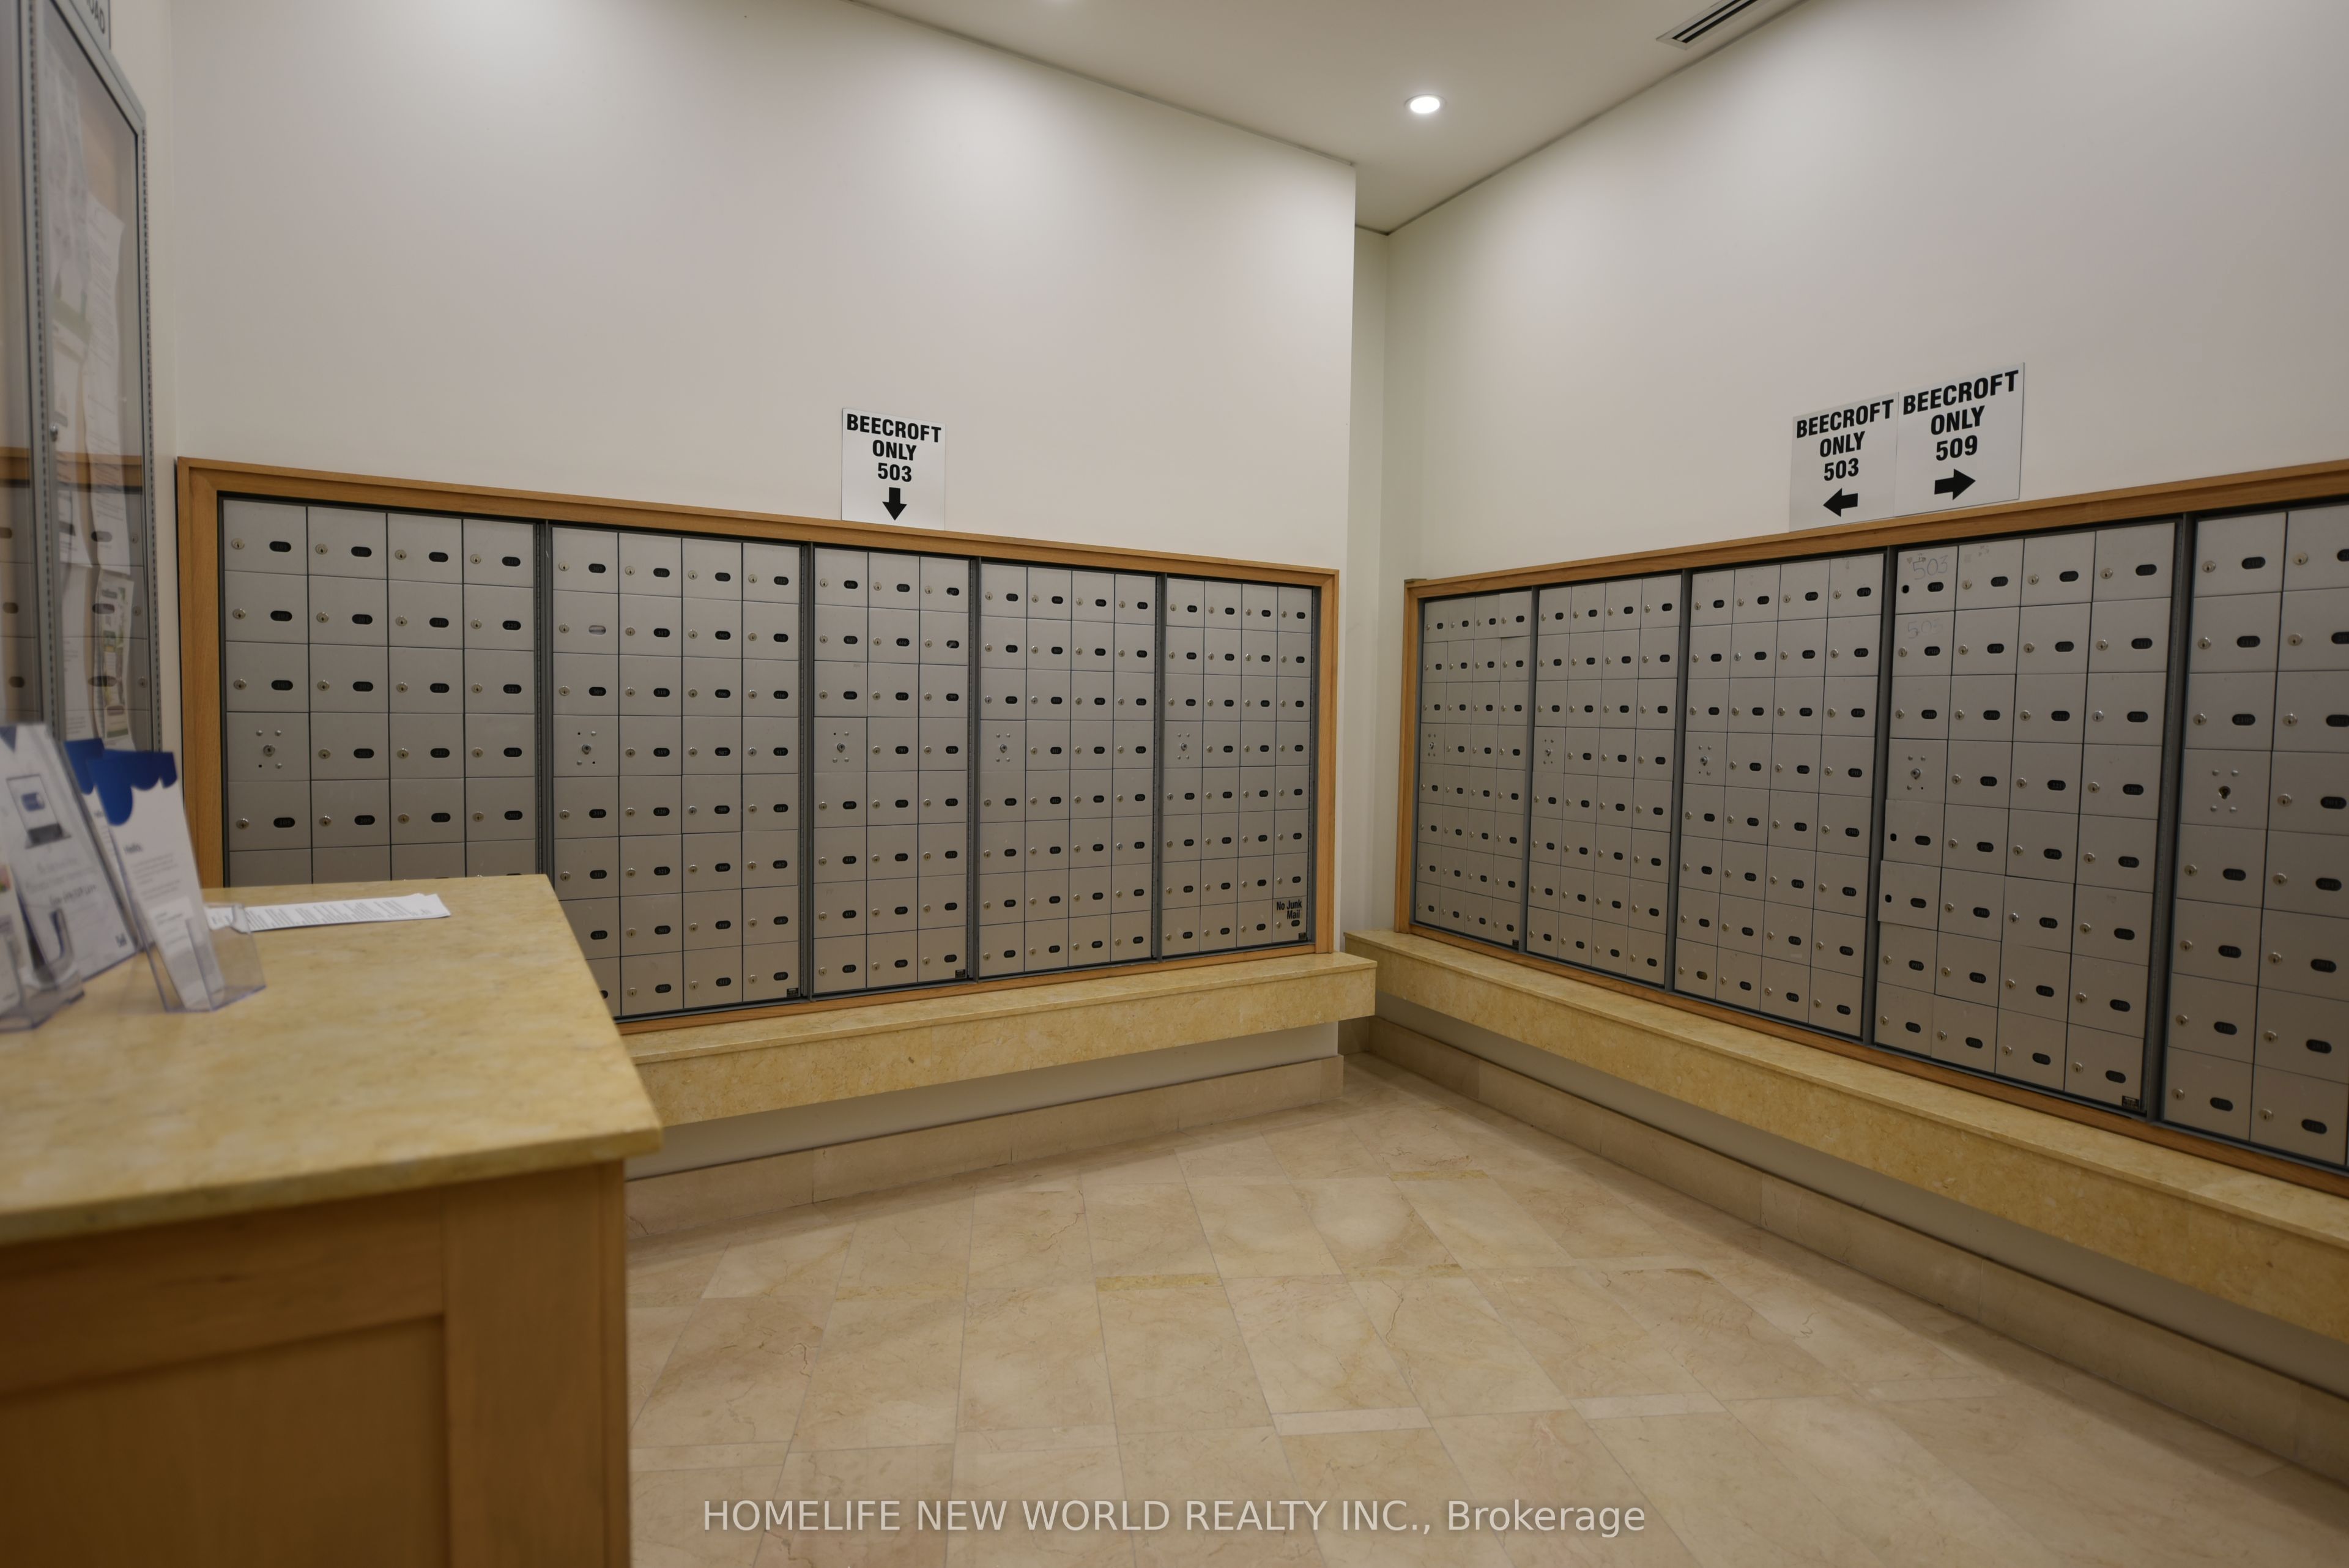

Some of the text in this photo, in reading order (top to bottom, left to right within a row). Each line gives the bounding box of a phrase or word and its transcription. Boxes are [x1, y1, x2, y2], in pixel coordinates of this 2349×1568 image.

[1903, 370, 2019, 415] BEECROFT
[847, 413, 941, 442] BEECROFT
[1796, 399, 1894, 439] BEECROFT
[1931, 405, 1985, 436] ONLY
[872, 439, 917, 461] ONLY
[1819, 430, 1866, 458] ONLY
[1935, 434, 1978, 461] 509
[877, 462, 912, 483] 503
[1824, 458, 1859, 481] 503
[1912, 554, 1948, 580] 503
[1276, 899, 1302, 911] No Junk
[1286, 909, 1301, 920] Mail
